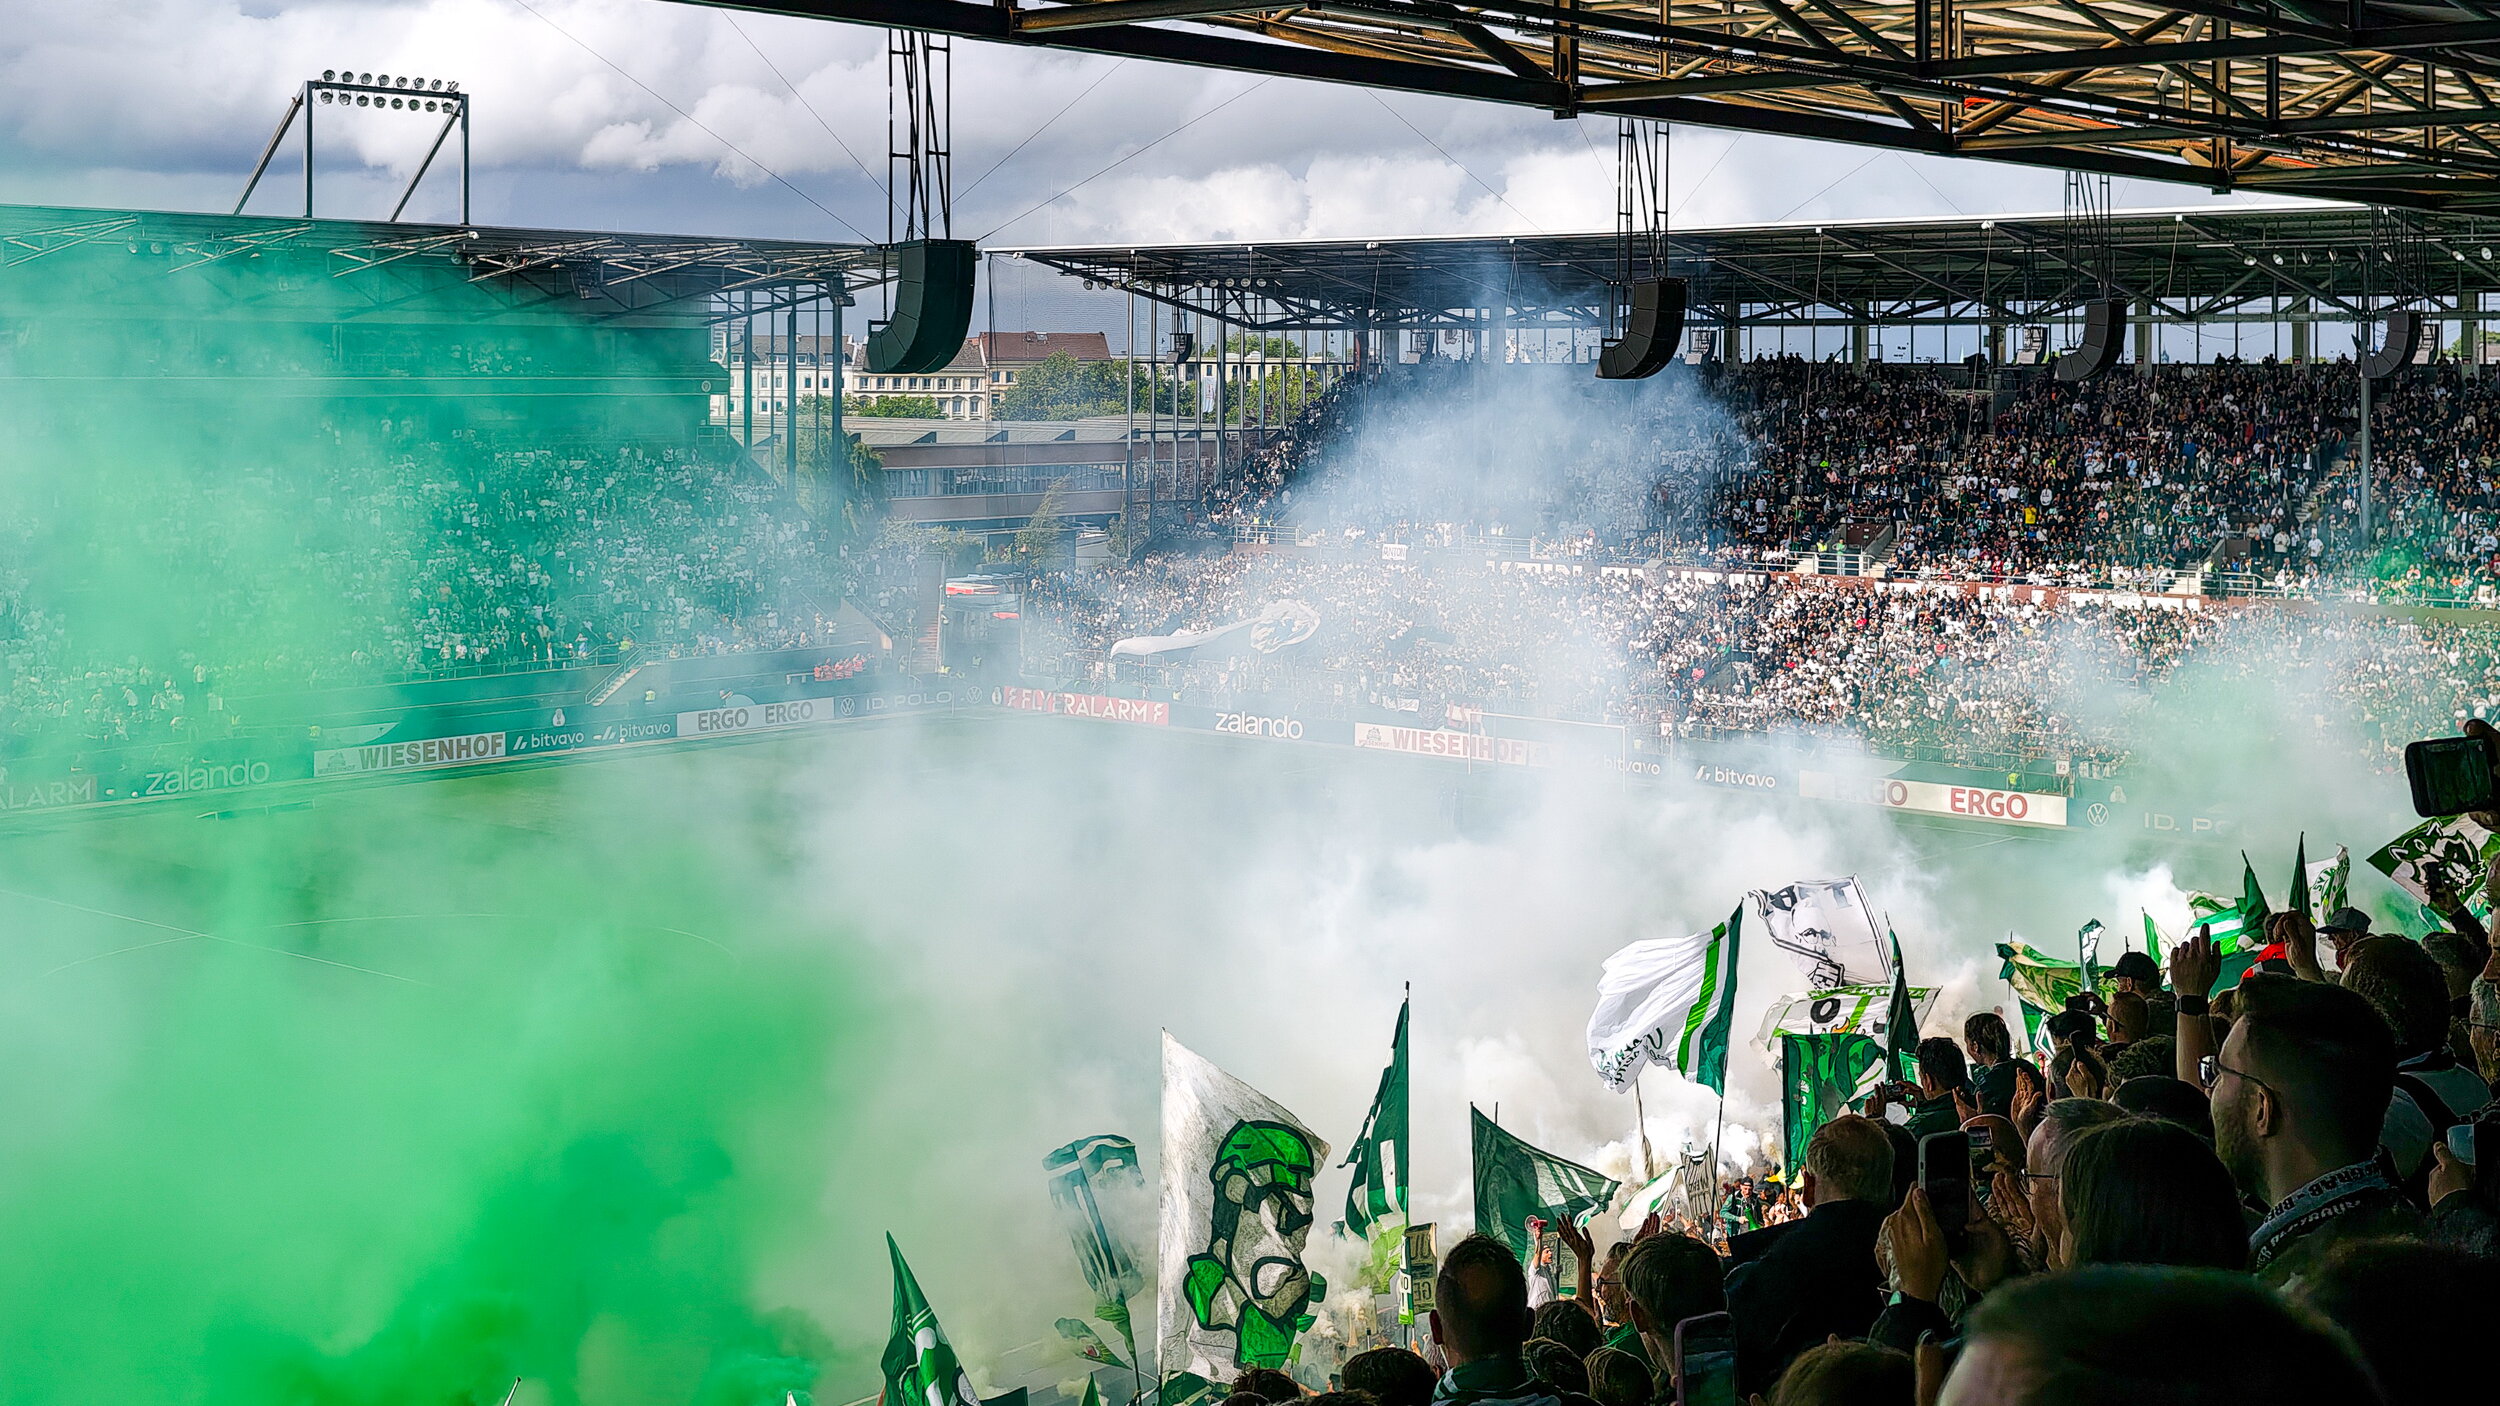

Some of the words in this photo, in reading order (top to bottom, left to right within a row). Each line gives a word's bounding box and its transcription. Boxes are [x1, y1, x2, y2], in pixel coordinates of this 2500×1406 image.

[895, 691, 952, 708] POLO
[1021, 689, 1148, 723] FLYERALARM
[697, 707, 750, 732] ERGO
[765, 701, 814, 725] ERGO
[1214, 711, 1304, 740] zalando
[530, 729, 585, 749] bitvavo
[618, 721, 672, 739] bitvavo
[359, 733, 505, 771] WIESENHOF
[1392, 728, 1525, 763] WIESENHOF
[145, 758, 270, 796] zalando
[1714, 766, 1777, 789] bitvavo
[1950, 787, 2028, 820] ERGO
[2144, 811, 2181, 832] ID.
